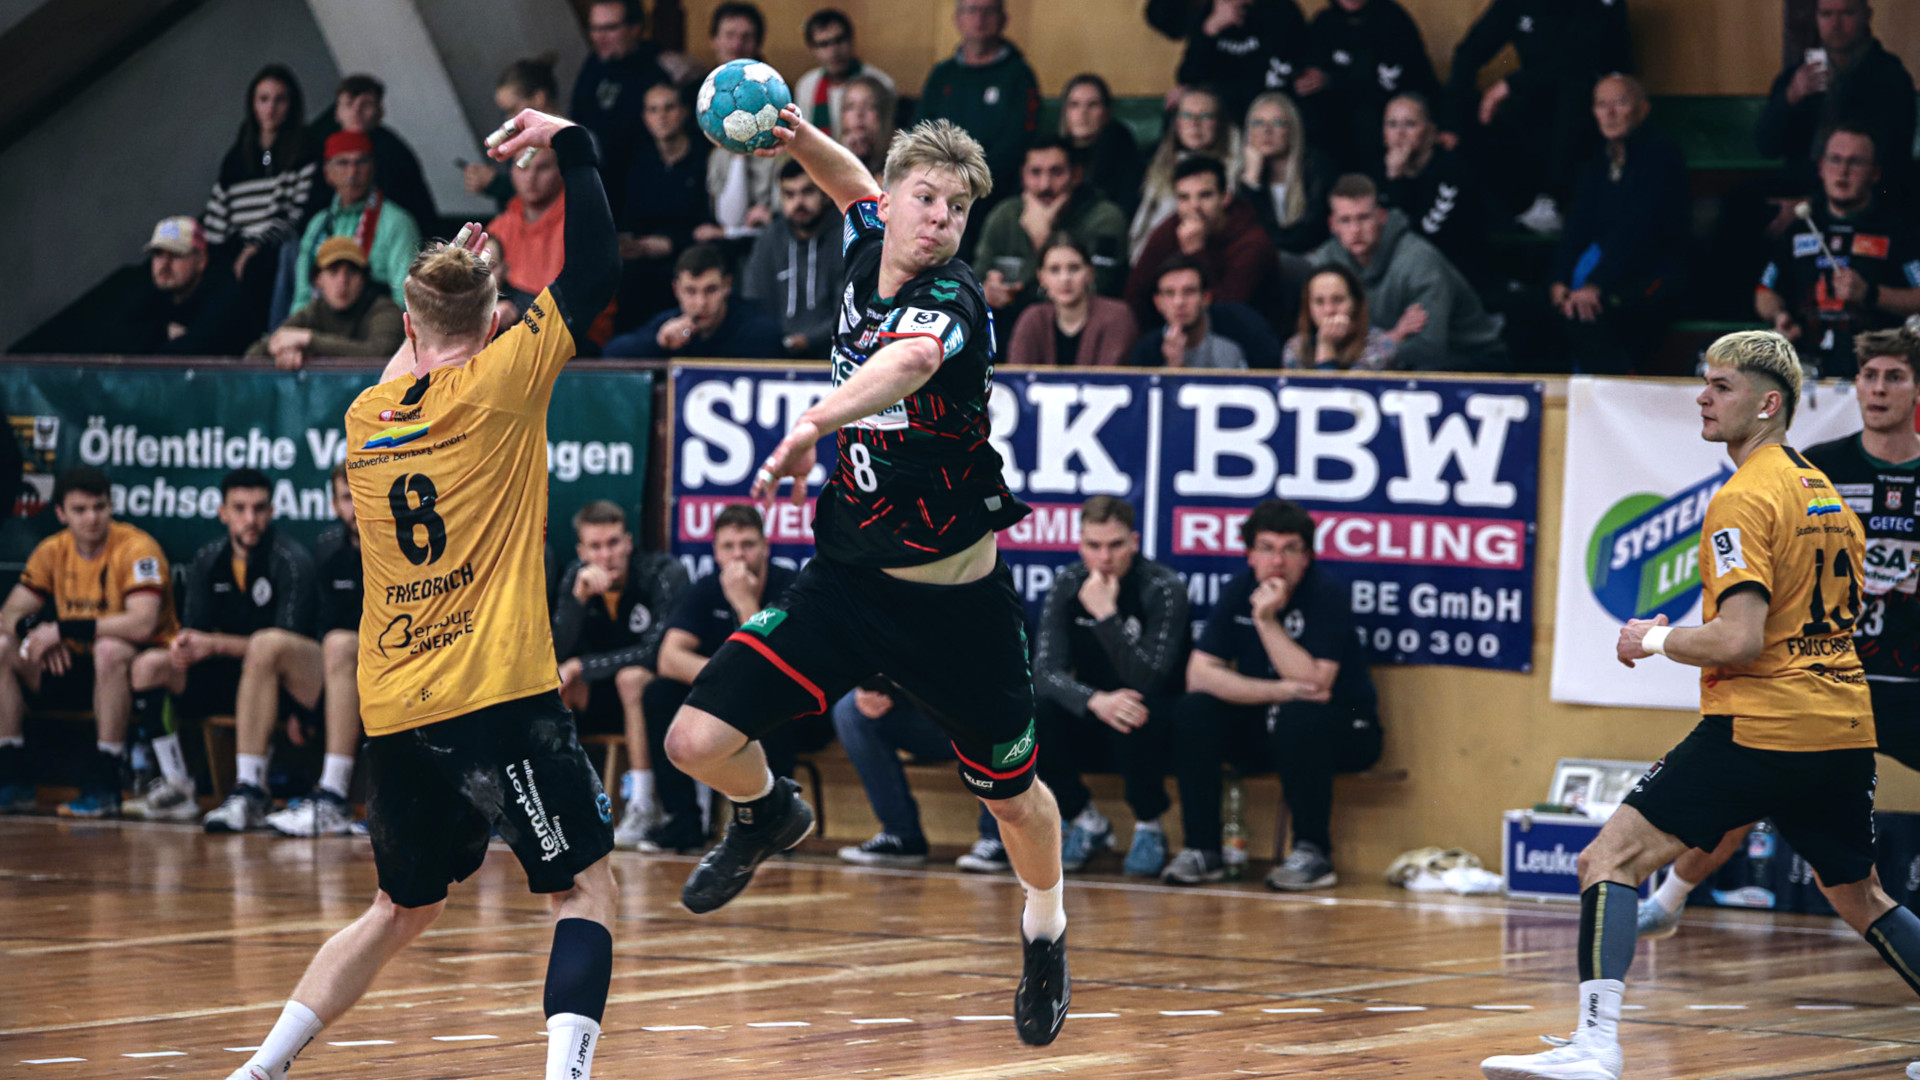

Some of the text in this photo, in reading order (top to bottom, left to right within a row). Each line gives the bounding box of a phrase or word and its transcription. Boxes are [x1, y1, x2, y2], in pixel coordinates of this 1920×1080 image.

[79, 415, 297, 469] Öffentliche
[1174, 383, 1529, 508] BBW
[850, 443, 877, 492] 8
[388, 473, 446, 566] 8
[1180, 513, 1518, 565] REYCLING
[1870, 516, 1914, 532] GETEC
[386, 562, 474, 605] FRIEDRICH
[1658, 544, 1699, 594] LIF
[1409, 582, 1522, 623] GmbH
[1429, 630, 1500, 658] 300
[1004, 729, 1032, 760] AOK
[577, 1033, 590, 1067] CRAFT
